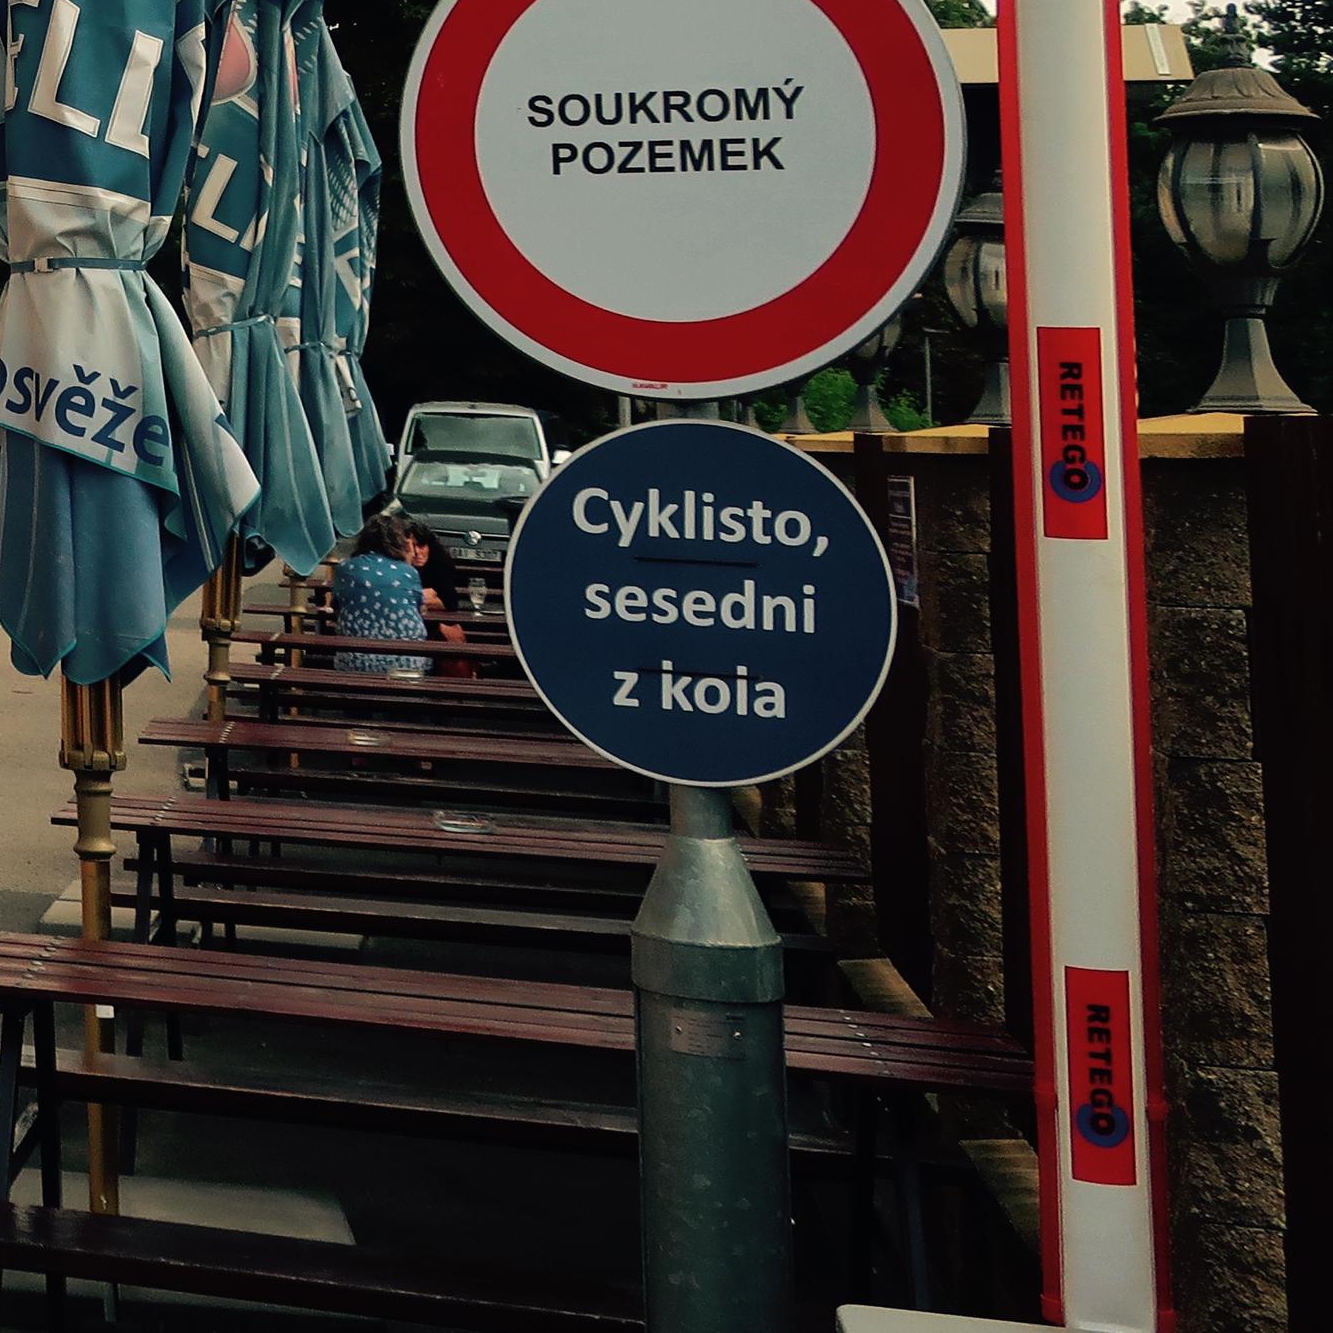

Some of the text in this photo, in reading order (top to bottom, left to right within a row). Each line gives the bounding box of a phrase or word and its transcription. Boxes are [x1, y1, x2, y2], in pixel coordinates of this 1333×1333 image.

[526, 78, 804, 128] SOUKROMÝ
[551, 136, 785, 175] POZEMEK
[1059, 362, 1089, 491] RETEGO
[572, 487, 829, 557] Cyklisto,
[584, 579, 815, 634] sesedni
[613, 659, 786, 719] z kola
[1086, 1004, 1116, 1136] RETEGO
